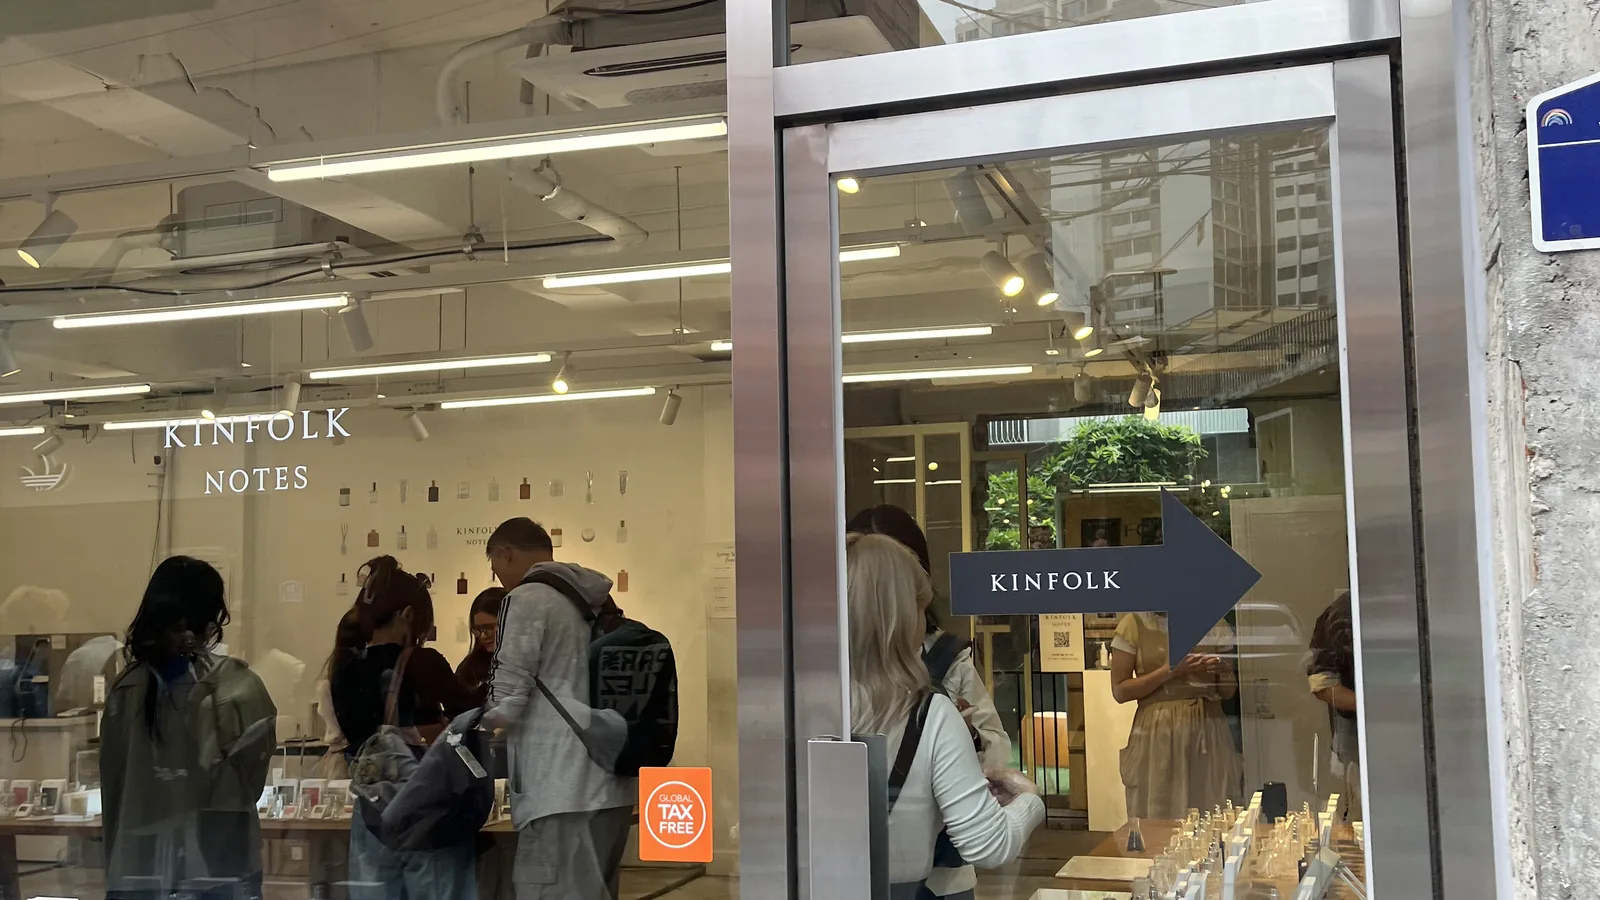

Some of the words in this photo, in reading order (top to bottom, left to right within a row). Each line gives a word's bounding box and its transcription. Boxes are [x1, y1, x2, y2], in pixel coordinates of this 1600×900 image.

[163, 407, 351, 448] KINFOLK
[204, 465, 308, 494] NOTES
[456, 526, 497, 535] KINFOL
[990, 570, 1121, 592] KINFOLK
[659, 794, 693, 803] GLOBAL
[657, 803, 694, 821] TAX
[659, 821, 694, 834] FREE
